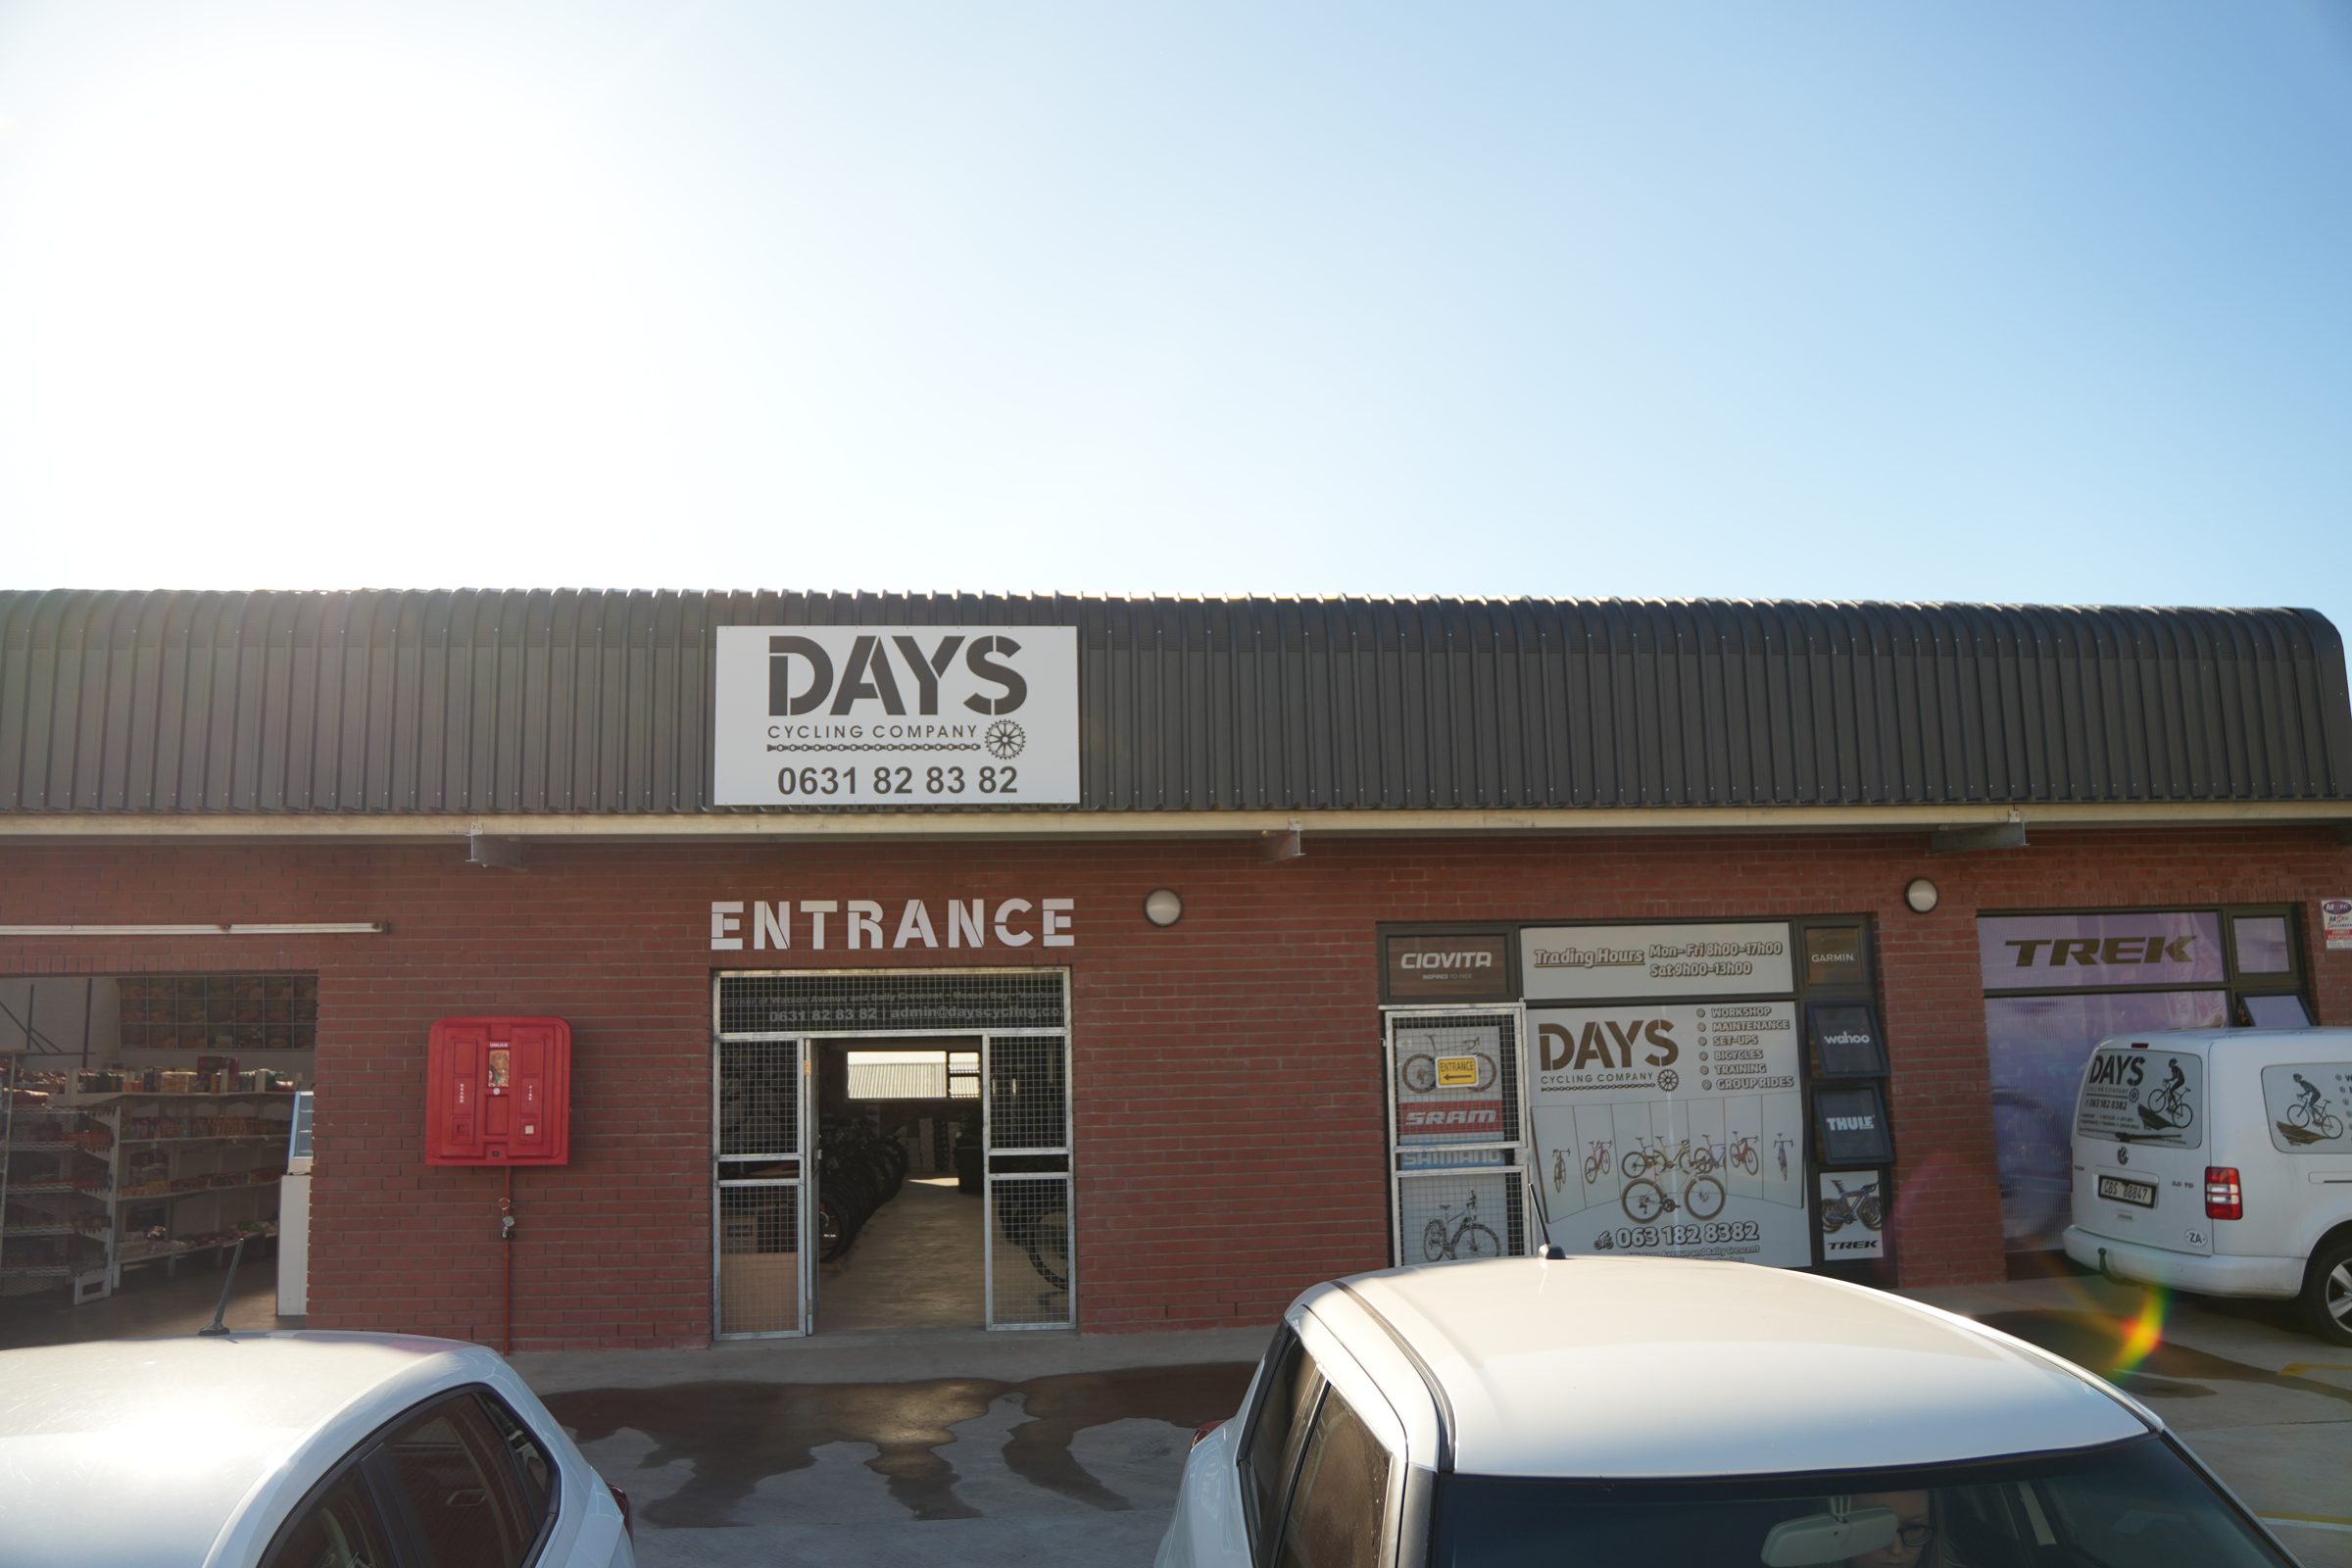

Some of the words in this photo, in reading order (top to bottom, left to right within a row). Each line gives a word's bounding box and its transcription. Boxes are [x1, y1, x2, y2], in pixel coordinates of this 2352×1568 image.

[769, 635, 1028, 716] DAYS
[767, 725, 864, 739] CYCLING
[873, 724, 978, 739] COMPANY
[778, 766, 857, 795] 0631
[873, 766, 912, 794] 82
[926, 766, 965, 794] 83
[978, 765, 1018, 794] 82
[710, 898, 1074, 951] ENTRANCE
[1686, 943, 1705, 957] Fri
[2005, 935, 2197, 967] TREK
[1400, 952, 1493, 969] CIOVITA
[1534, 948, 1597, 968] Trading
[1597, 947, 1644, 963] Hours
[1811, 953, 1854, 962] GARMIN
[1650, 963, 1674, 977] Sat
[769, 1011, 806, 1022] 0631
[811, 1010, 831, 1021] 82
[835, 1009, 854, 1020] 83
[858, 1008, 878, 1020] 82
[1711, 1006, 1772, 1018] WORKSHOP
[1712, 1020, 1790, 1032] MAINTENANCE
[1713, 1035, 1759, 1046] SET-UPS
[1824, 1030, 1870, 1045] wahoo
[1538, 1019, 1679, 1071] DAYS
[1714, 1050, 1764, 1061] BICYCLES
[1440, 1060, 1474, 1073] ENTRANCE
[1715, 1064, 1767, 1075] TRAINING
[2089, 1054, 2146, 1086] DAYS
[1541, 1074, 1593, 1085] CYCLING
[1597, 1072, 1654, 1083] COMPANY
[1716, 1078, 1758, 1090] GROUP
[1759, 1076, 1795, 1089] RIDES
[1406, 1109, 1497, 1126] SRAM
[1826, 1116, 1874, 1130] THULE
[1617, 1226, 1660, 1248] 063
[1662, 1224, 1701, 1246] 182
[1704, 1221, 1760, 1243] 8382
[2189, 1232, 2202, 1244] ZA
[1828, 1240, 1878, 1250] TREK
